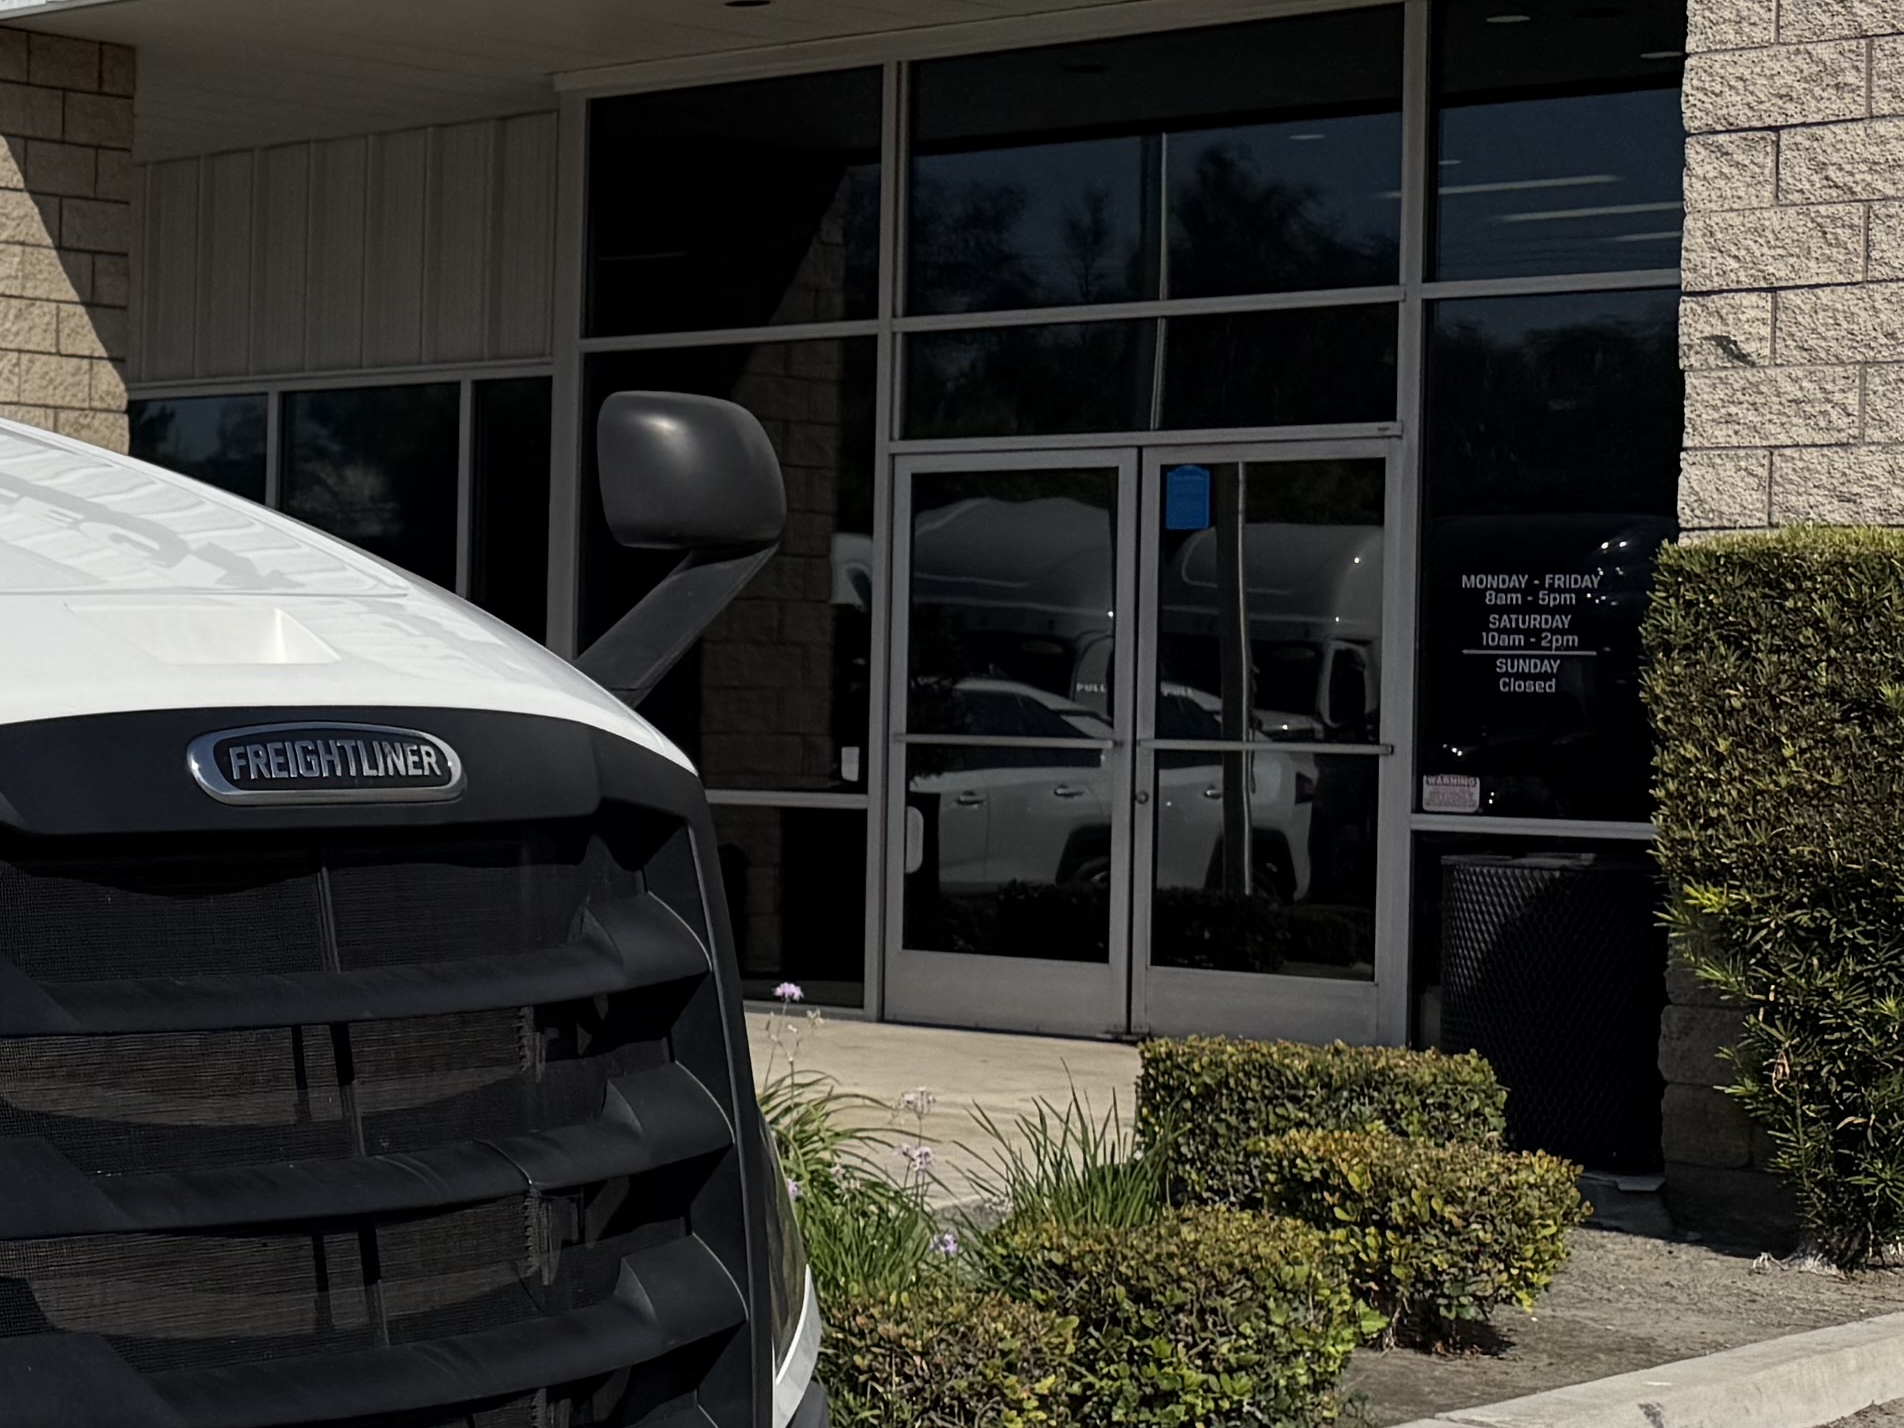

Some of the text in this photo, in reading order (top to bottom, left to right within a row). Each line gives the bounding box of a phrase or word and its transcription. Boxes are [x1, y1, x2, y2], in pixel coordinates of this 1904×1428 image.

[1461, 573, 1529, 589] MONDAY
[1545, 573, 1601, 589] FRIDAY
[1485, 590, 1522, 605] 8am
[1538, 590, 1577, 608] 5pm
[1489, 614, 1572, 629] SATURDAY
[1482, 631, 1525, 647] 10am
[1541, 632, 1579, 651] 2pm
[1495, 658, 1561, 674] SUNDAY
[1076, 682, 1107, 693] PULL
[1499, 677, 1556, 693] Closed
[229, 740, 442, 780] FREIGHTLINER
